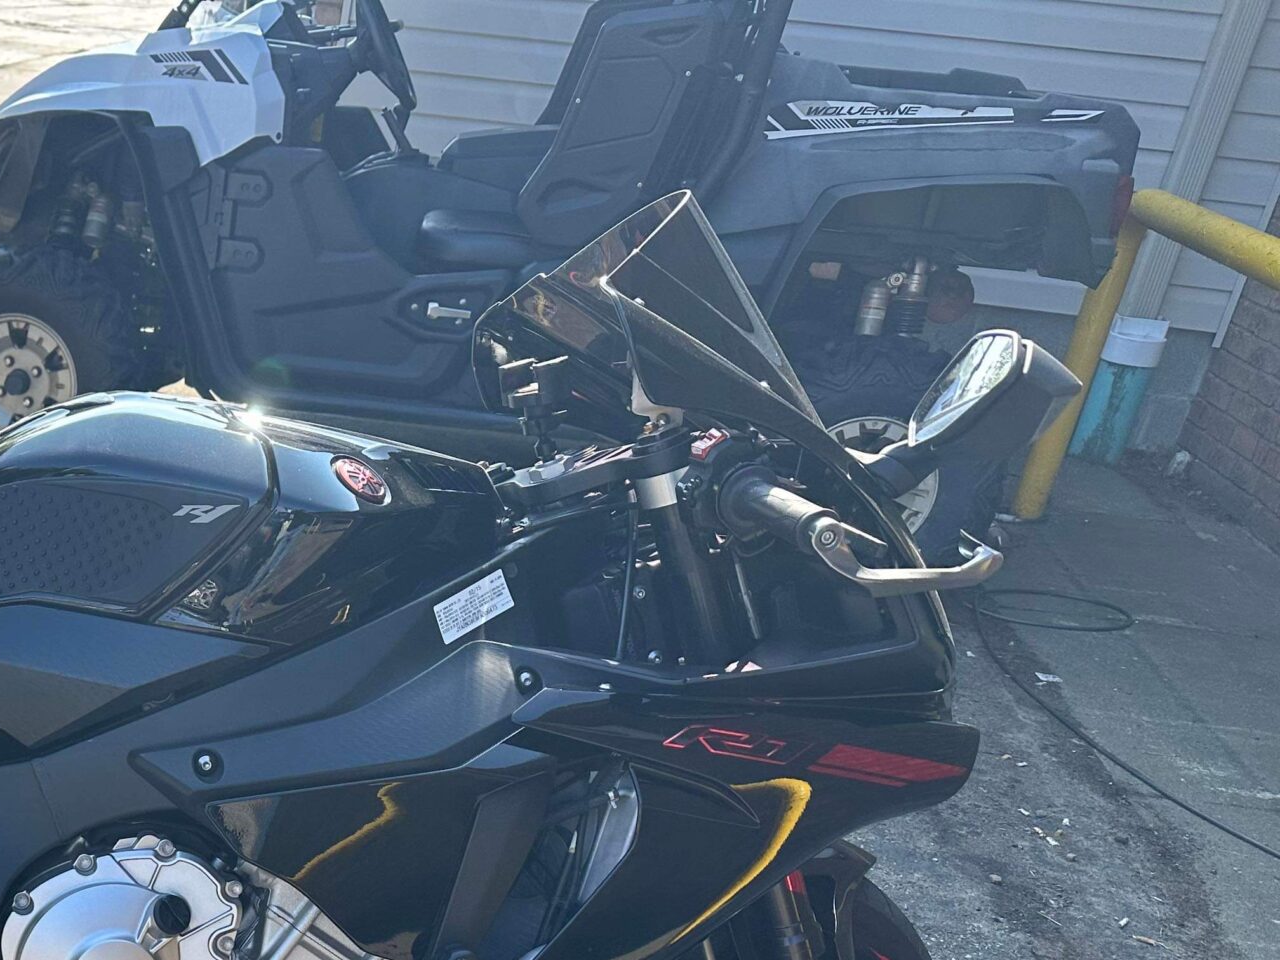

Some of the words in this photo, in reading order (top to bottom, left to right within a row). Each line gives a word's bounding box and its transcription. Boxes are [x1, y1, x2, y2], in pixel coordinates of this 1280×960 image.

[161, 66, 202, 77] 4x4
[806, 106, 922, 116] WOLVERINE
[172, 504, 241, 524] R1
[663, 725, 816, 765] R1
